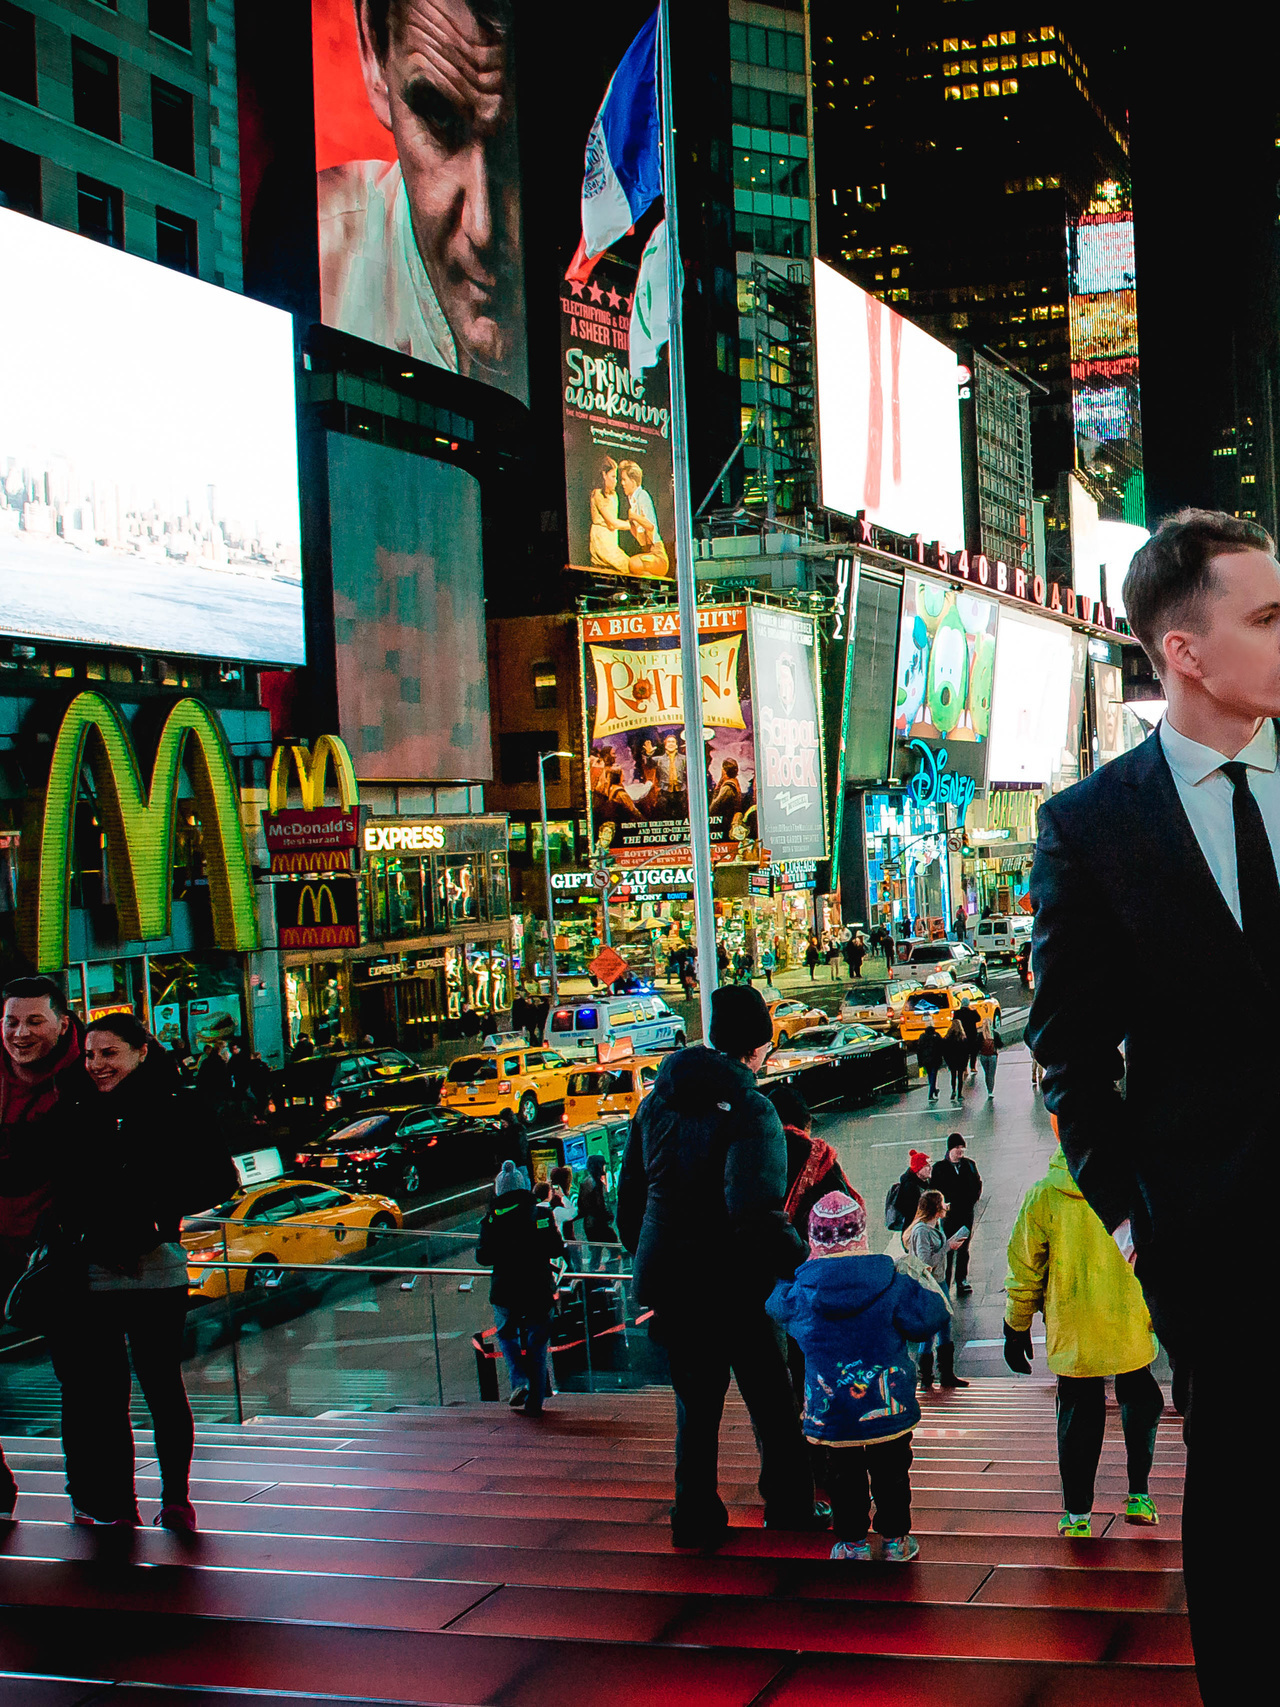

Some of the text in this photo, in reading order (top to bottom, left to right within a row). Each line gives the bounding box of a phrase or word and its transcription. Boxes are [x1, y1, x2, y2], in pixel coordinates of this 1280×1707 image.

[570, 317, 578, 337] A
[579, 321, 611, 346] SHEER
[565, 348, 647, 399] SPRING
[565, 383, 670, 439] awakening
[612, 646, 719, 666] SOMETHNG
[761, 705, 818, 748] SCHOOL
[766, 747, 817, 787] ROCK
[268, 819, 354, 837] McDonald's
[623, 832, 723, 844] THE BOOK OF MON
[283, 836, 339, 846] Restaurant
[364, 826, 445, 851] EXPRESS
[550, 868, 714, 889] GIFT LUGGAG
[630, 885, 647, 893] NY
[369, 964, 401, 976] EXPRESS
[416, 958, 446, 969] EXPRESS
